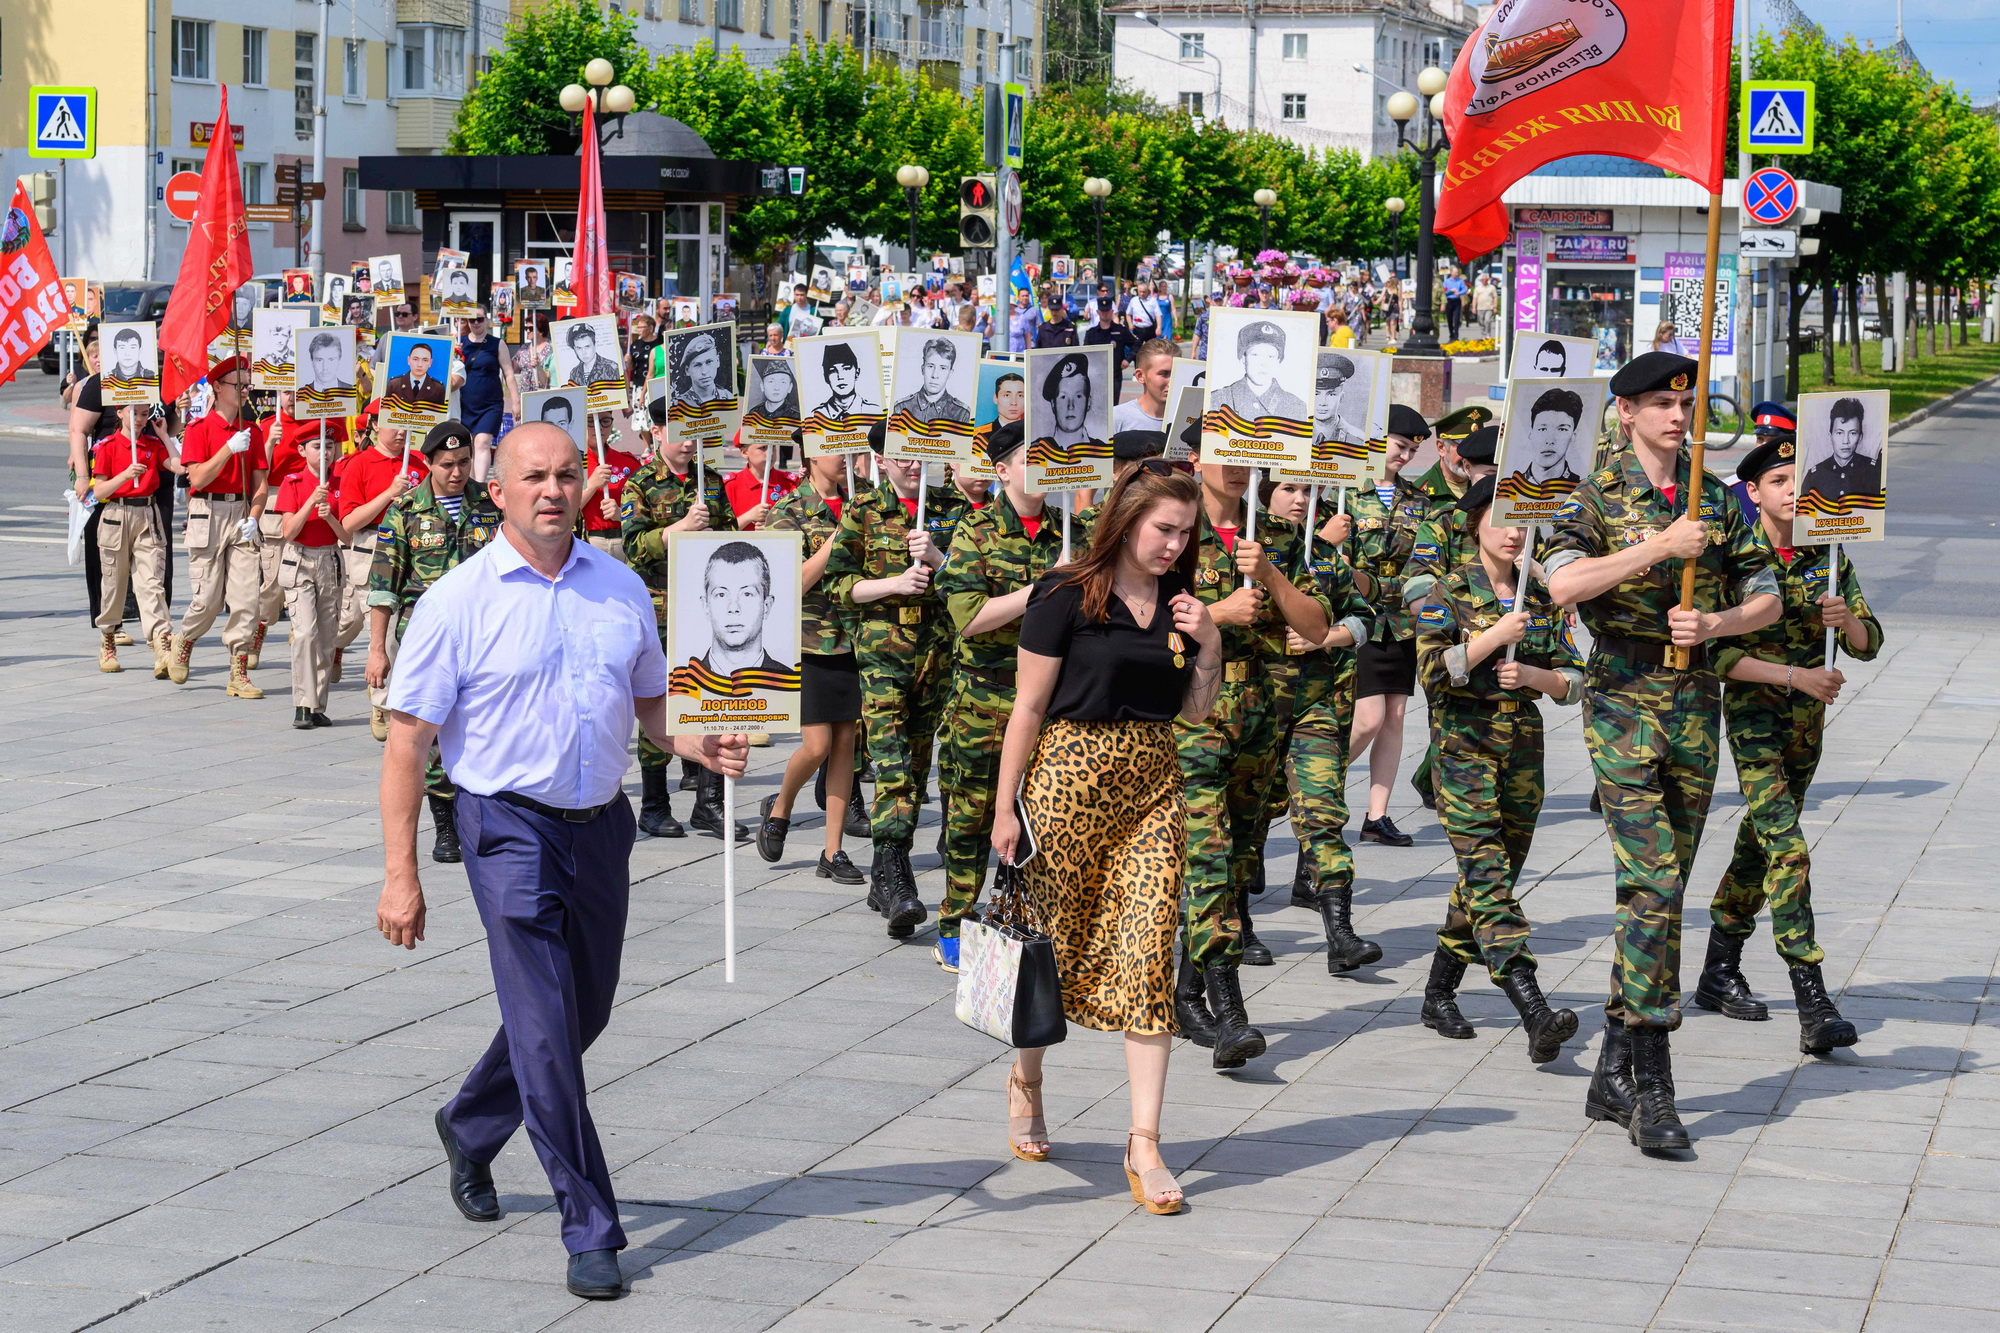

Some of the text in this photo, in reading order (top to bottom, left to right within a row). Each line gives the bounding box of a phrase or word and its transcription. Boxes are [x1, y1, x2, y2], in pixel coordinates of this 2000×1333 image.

[1528, 210, 1599, 223] САЛЮТЫ
[1555, 239, 1626, 250] ZALP12.RU
[1670, 256, 1732, 268] PARILK12
[1669, 267, 1695, 276] 12:00
[1519, 263, 1538, 332] LKA.12
[309, 401, 342, 409] КУЗНЕЦОВ
[390, 412, 435, 421] СИДЫГАНОВ
[686, 417, 720, 428] ЧЕРНЯЕВ
[825, 432, 866, 443] ПЕТУХОВ
[908, 437, 951, 448] ТРУШКОВ
[1229, 438, 1284, 452] СОКОЛОВ
[920, 447, 956, 455] Васильевич
[1214, 449, 1296, 461] Сергей Вениаминович
[1045, 466, 1094, 477] ЛУКИЯНОВ
[1280, 468, 1356, 480] Николай Анатольевич
[1064, 475, 1101, 485] Григорьевич
[1815, 517, 1864, 528] КУЗНЕЦОВ
[1808, 527, 1871, 536] Виталий Леонидович
[701, 699, 767, 711] ЛОГИНОВ
[679, 713, 789, 724] Дмитрий Александрович
